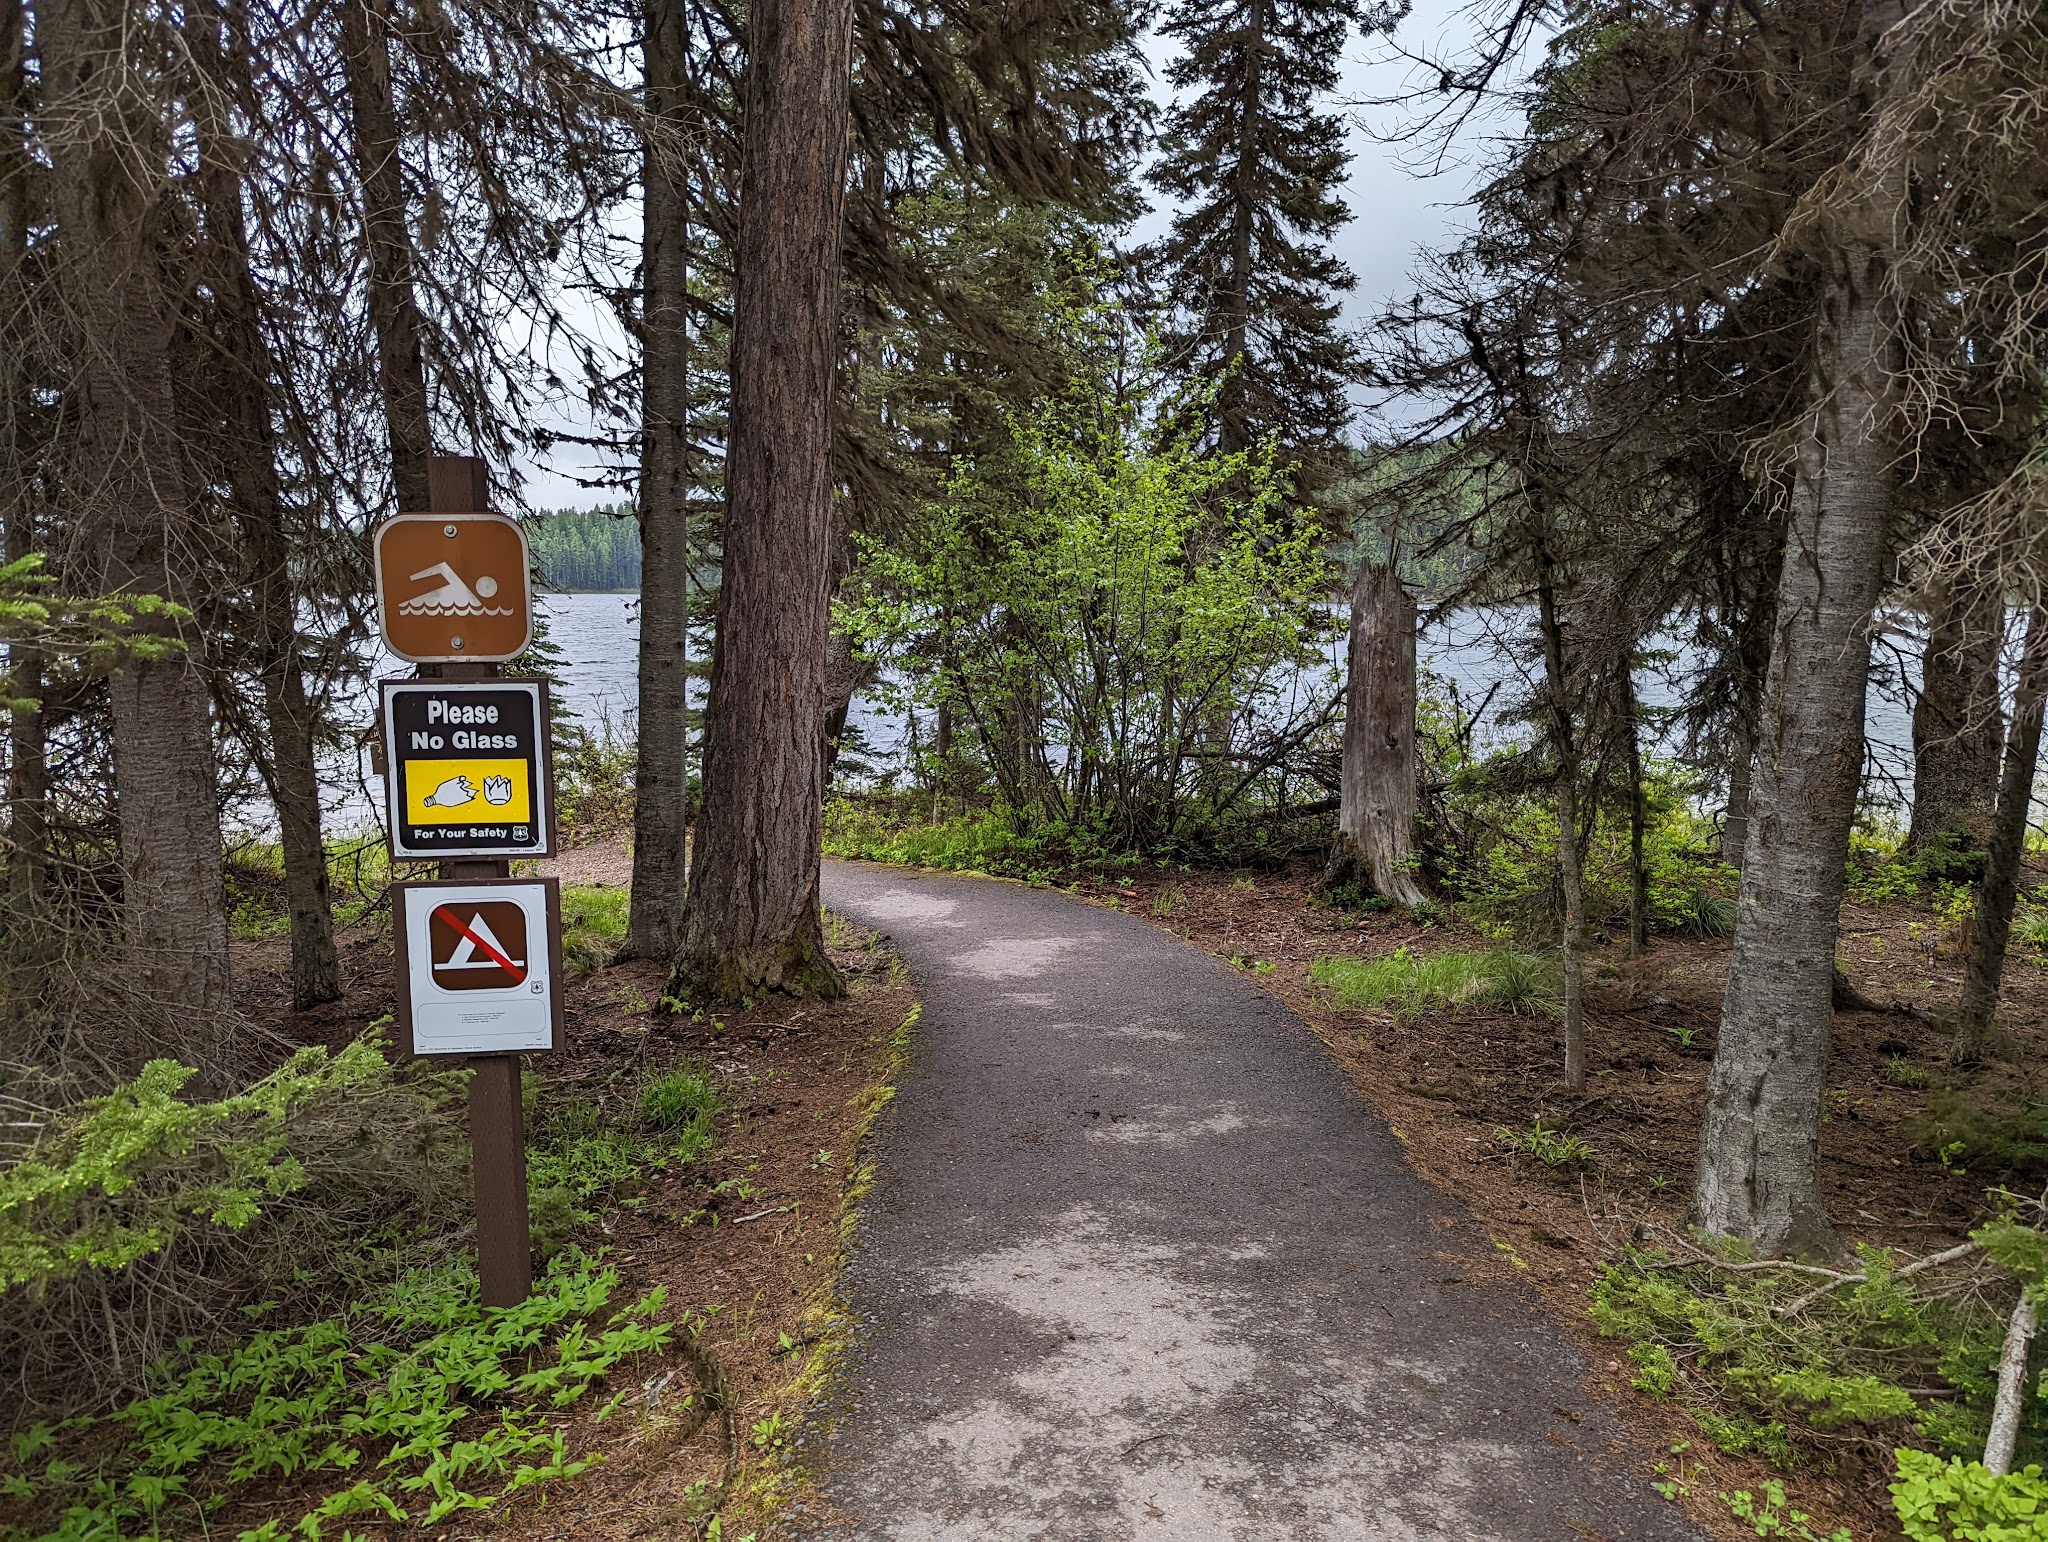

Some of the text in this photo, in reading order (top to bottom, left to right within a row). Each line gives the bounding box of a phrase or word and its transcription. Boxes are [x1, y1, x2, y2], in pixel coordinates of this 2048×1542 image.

[427, 700, 499, 724] Please
[411, 731, 518, 750] No Glass
[414, 827, 508, 839] For Your Safety
